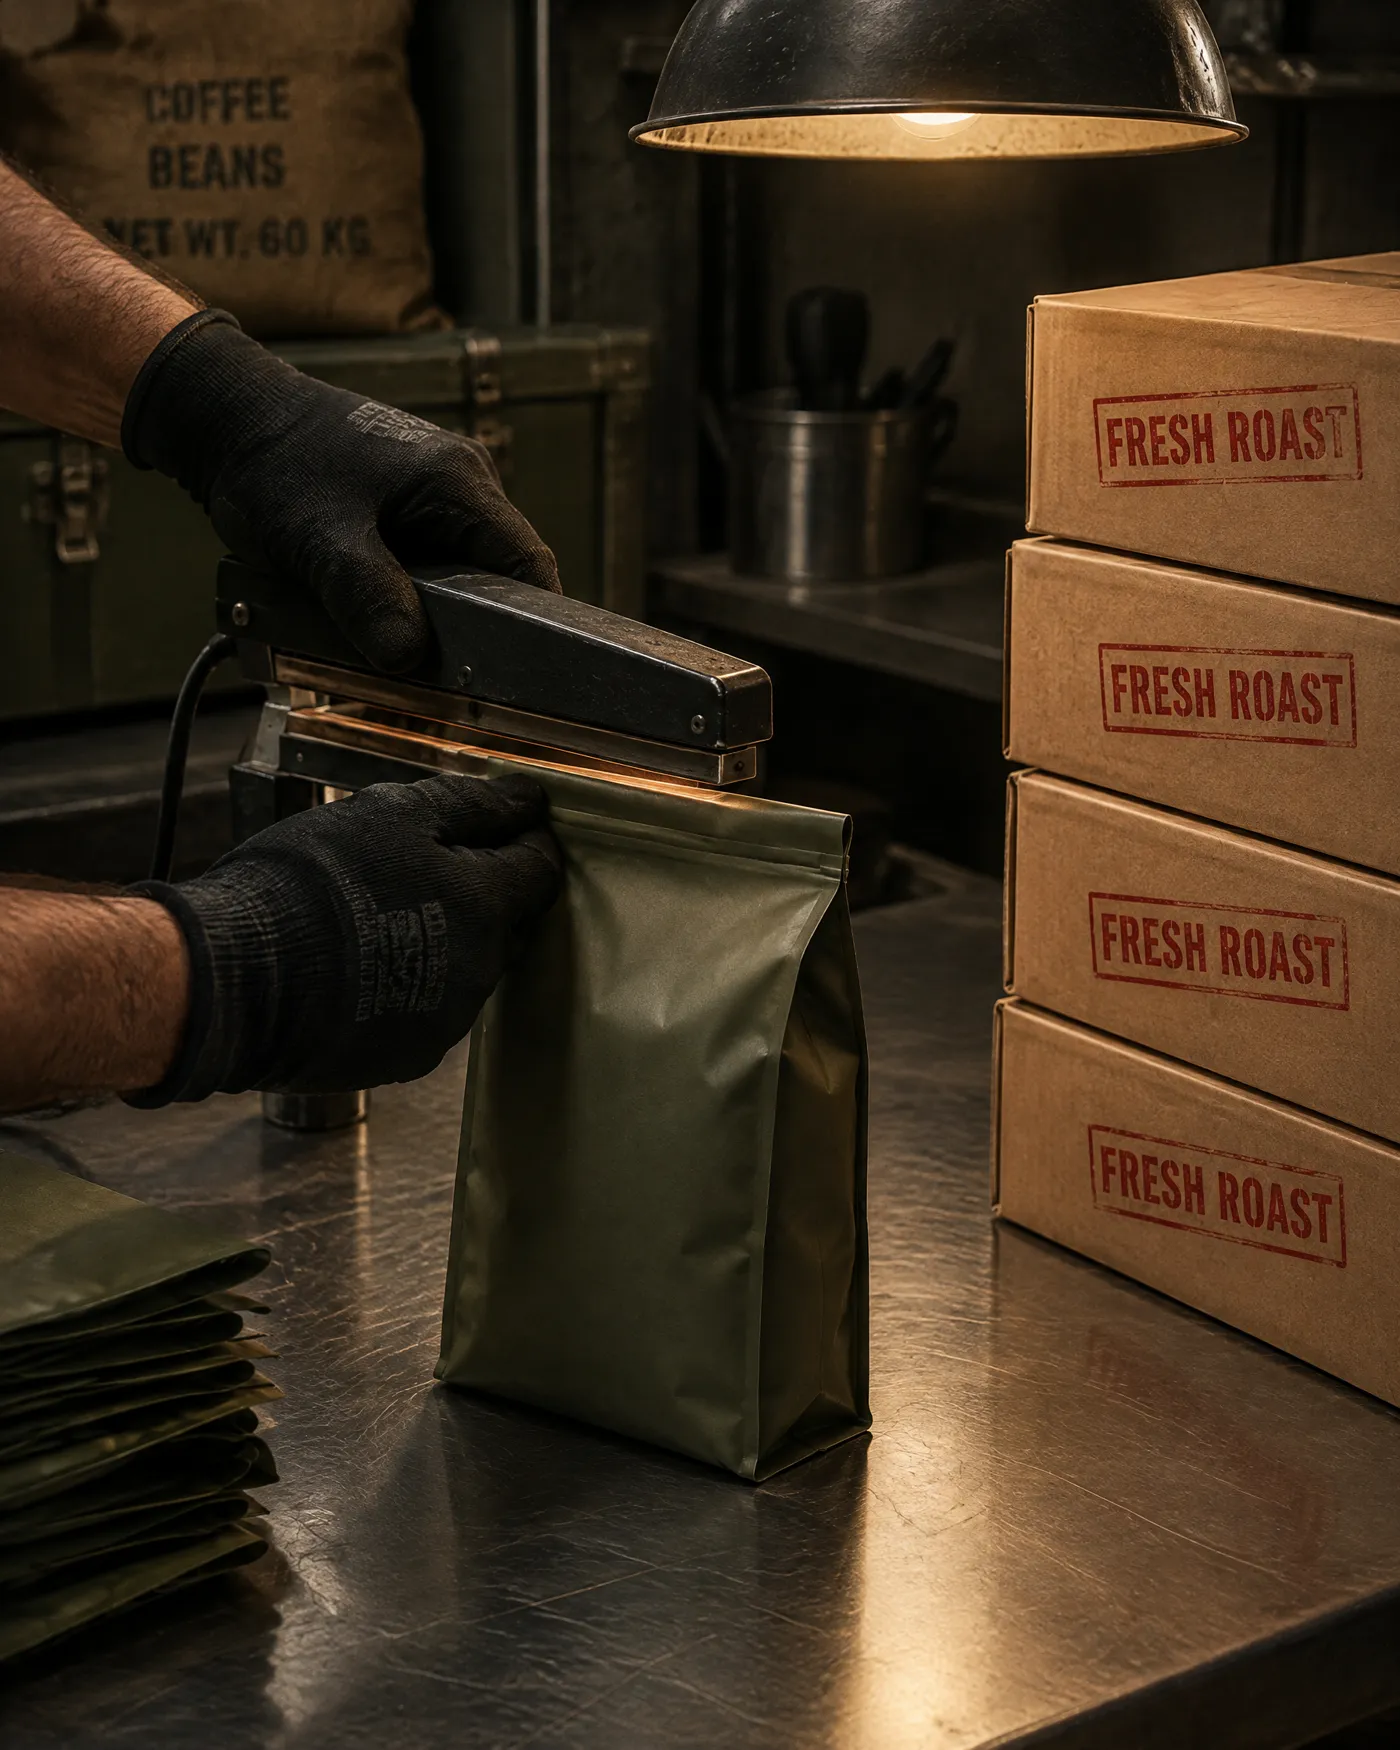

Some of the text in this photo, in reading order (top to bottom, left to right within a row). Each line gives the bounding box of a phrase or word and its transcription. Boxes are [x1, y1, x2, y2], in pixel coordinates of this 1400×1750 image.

[145, 76, 290, 124] COFFEE
[149, 143, 285, 189] BEANS
[183, 218, 249, 259] WT.
[258, 215, 308, 258] 60
[321, 216, 371, 258] KG
[1106, 406, 1347, 467] FRESH ROAST
[1111, 664, 1343, 725] FRESH ROAST
[1101, 913, 1335, 987] FRESH ROAST
[1101, 1145, 1332, 1243] FRESH ROAST
